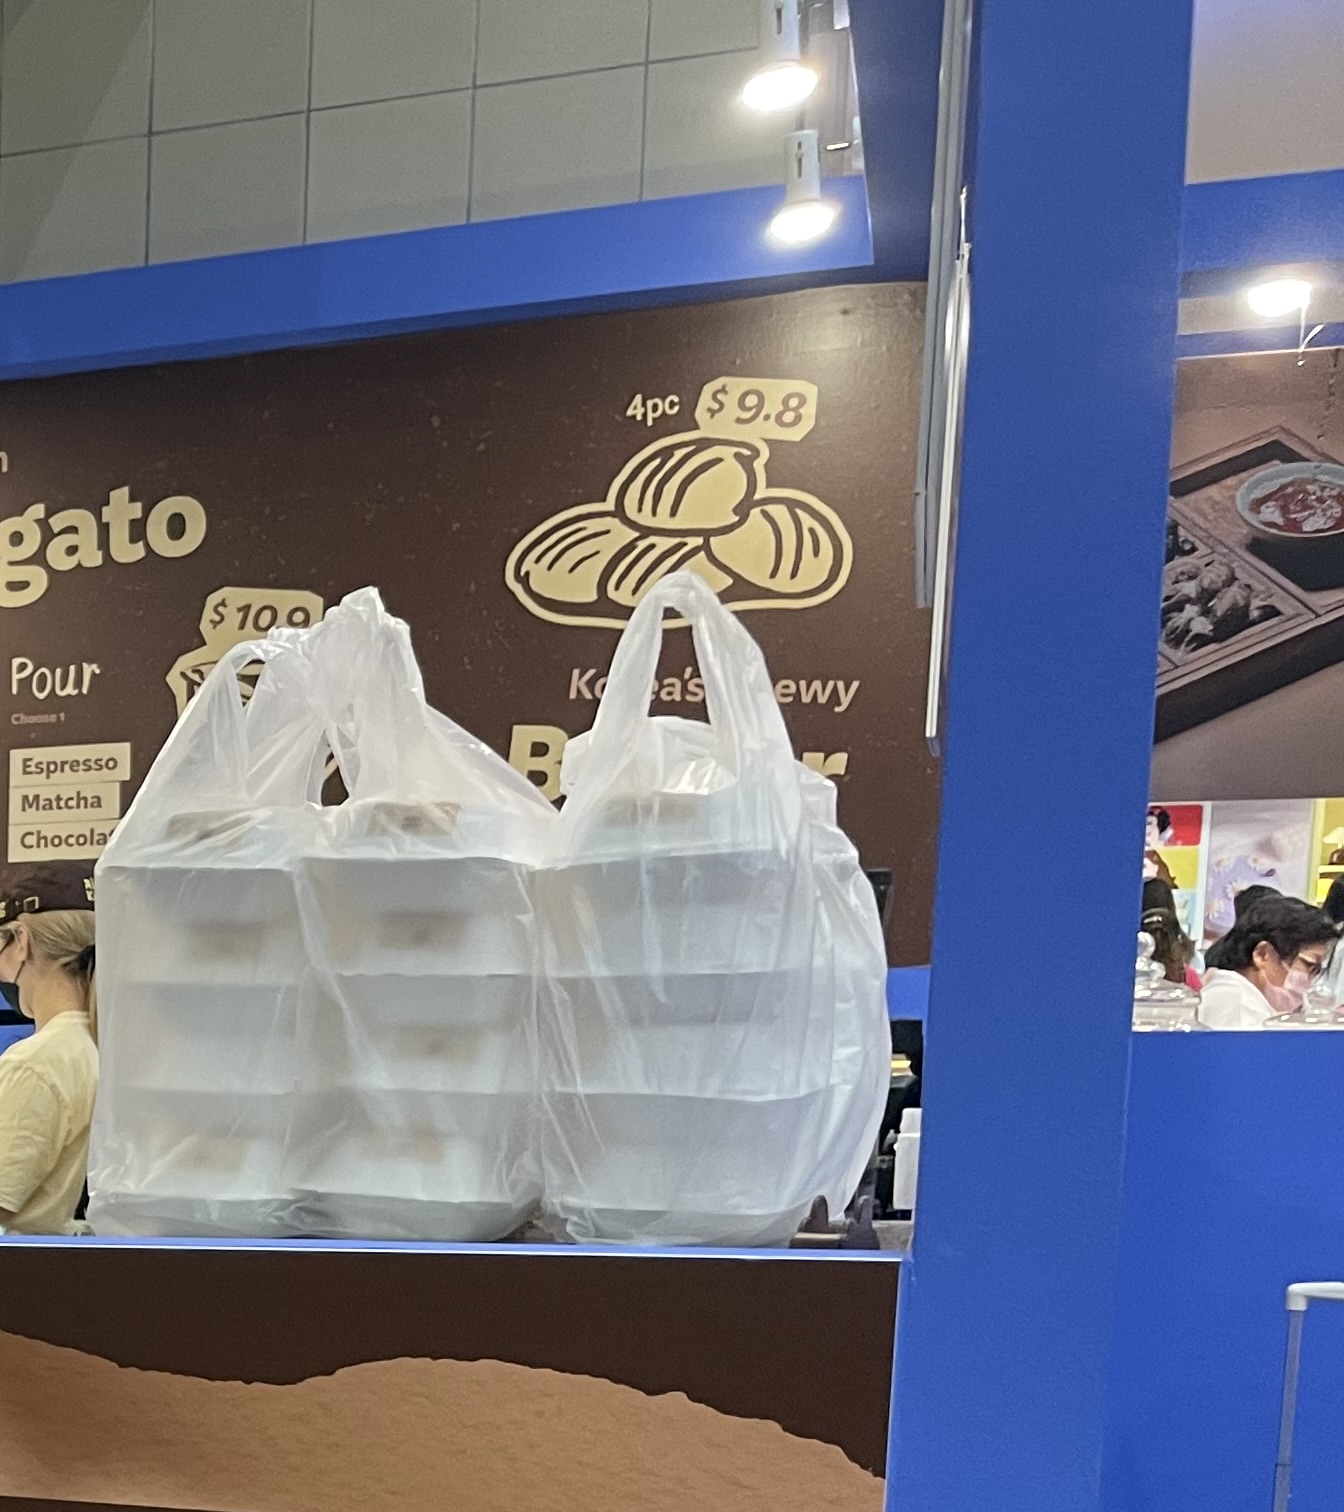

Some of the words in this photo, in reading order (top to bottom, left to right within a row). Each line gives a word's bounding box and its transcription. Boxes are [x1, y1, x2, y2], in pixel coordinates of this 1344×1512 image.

[626, 393, 680, 426] 4pc
[209, 598, 310, 632] $109
[11, 658, 101, 699] Pour
[11, 713, 57, 724] Choose
[22, 757, 118, 779] Espresso
[21, 790, 102, 812] Matcha
[20, 828, 114, 849] Chocola
